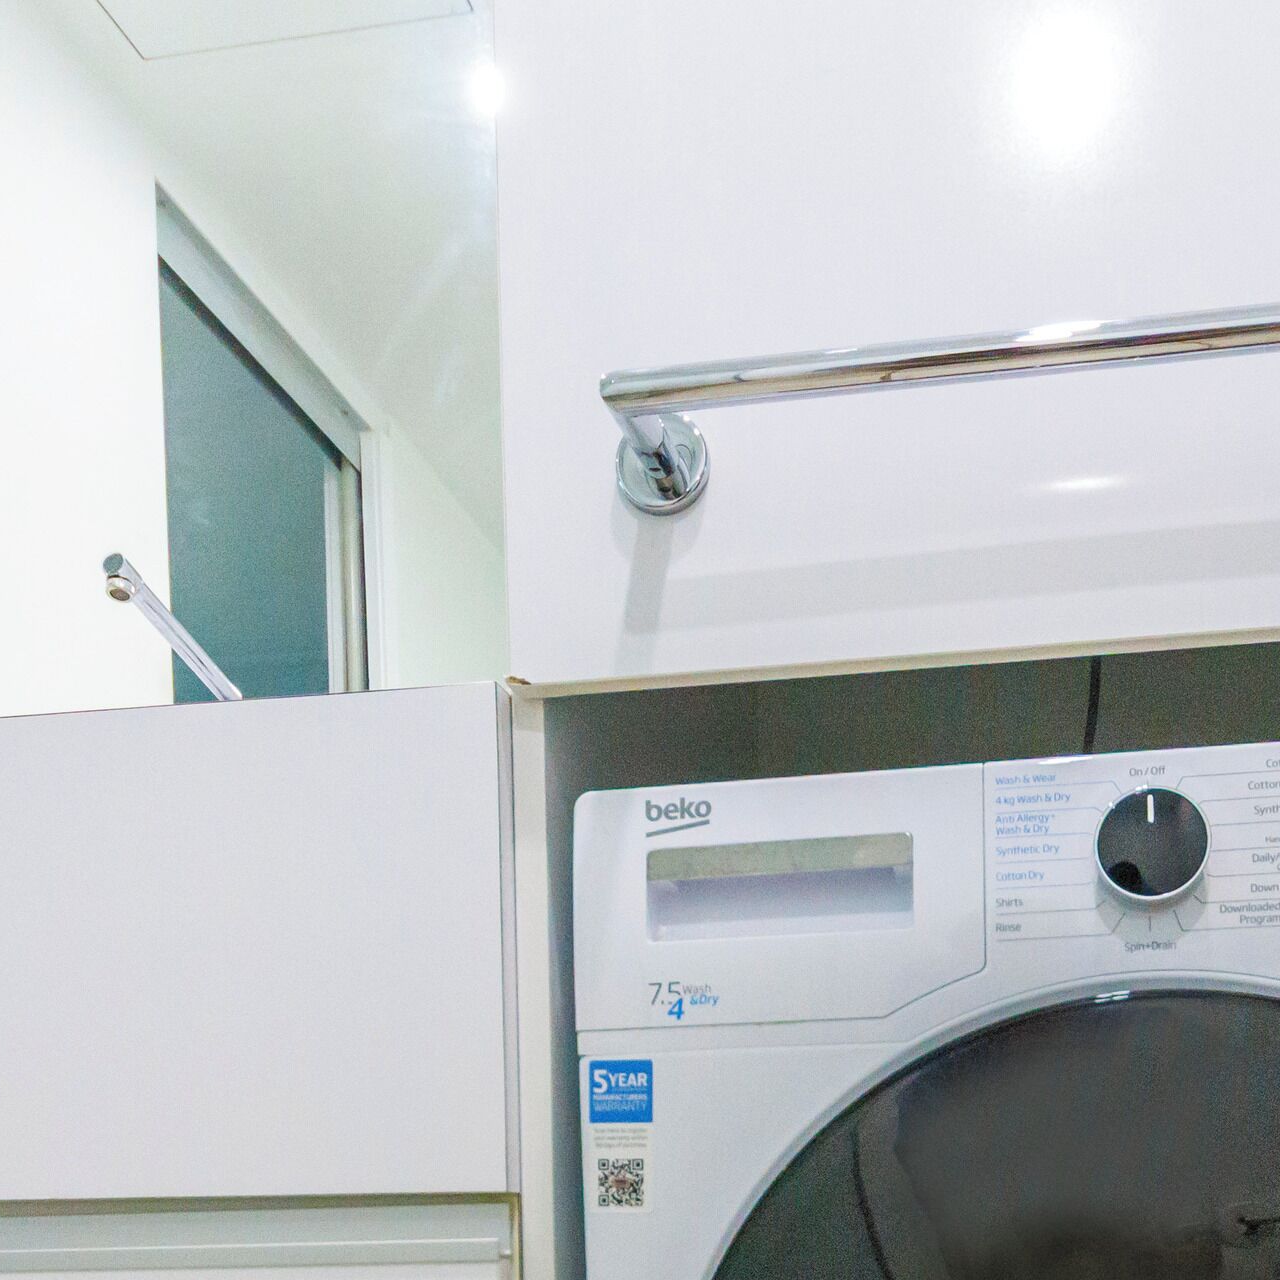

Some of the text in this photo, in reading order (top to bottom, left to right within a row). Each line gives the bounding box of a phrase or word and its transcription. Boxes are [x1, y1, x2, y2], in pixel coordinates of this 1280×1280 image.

[1129, 767, 1142, 777] On
[1151, 765, 1166, 776] Off
[995, 774, 1056, 785] Wash & Wear
[1003, 796, 1015, 806] kg
[1017, 794, 1041, 804] Wash
[1044, 793, 1052, 802] &
[1054, 792, 1071, 803] Dry
[645, 797, 712, 823] beko
[995, 815, 1015, 824] Anti
[995, 824, 1050, 836] Wash & Dry
[995, 843, 1060, 856] Synthetic Dry
[995, 870, 1044, 882] Cotton Dry
[1250, 883, 1279, 893] Down
[995, 897, 1023, 908] Shirts
[1219, 902, 1280, 914] Downloaded
[1239, 914, 1280, 925] Program
[995, 922, 1021, 933] Rinse
[682, 984, 712, 995] Wash
[667, 998, 685, 1021] 4
[592, 1069, 648, 1094] 5 YEAR
